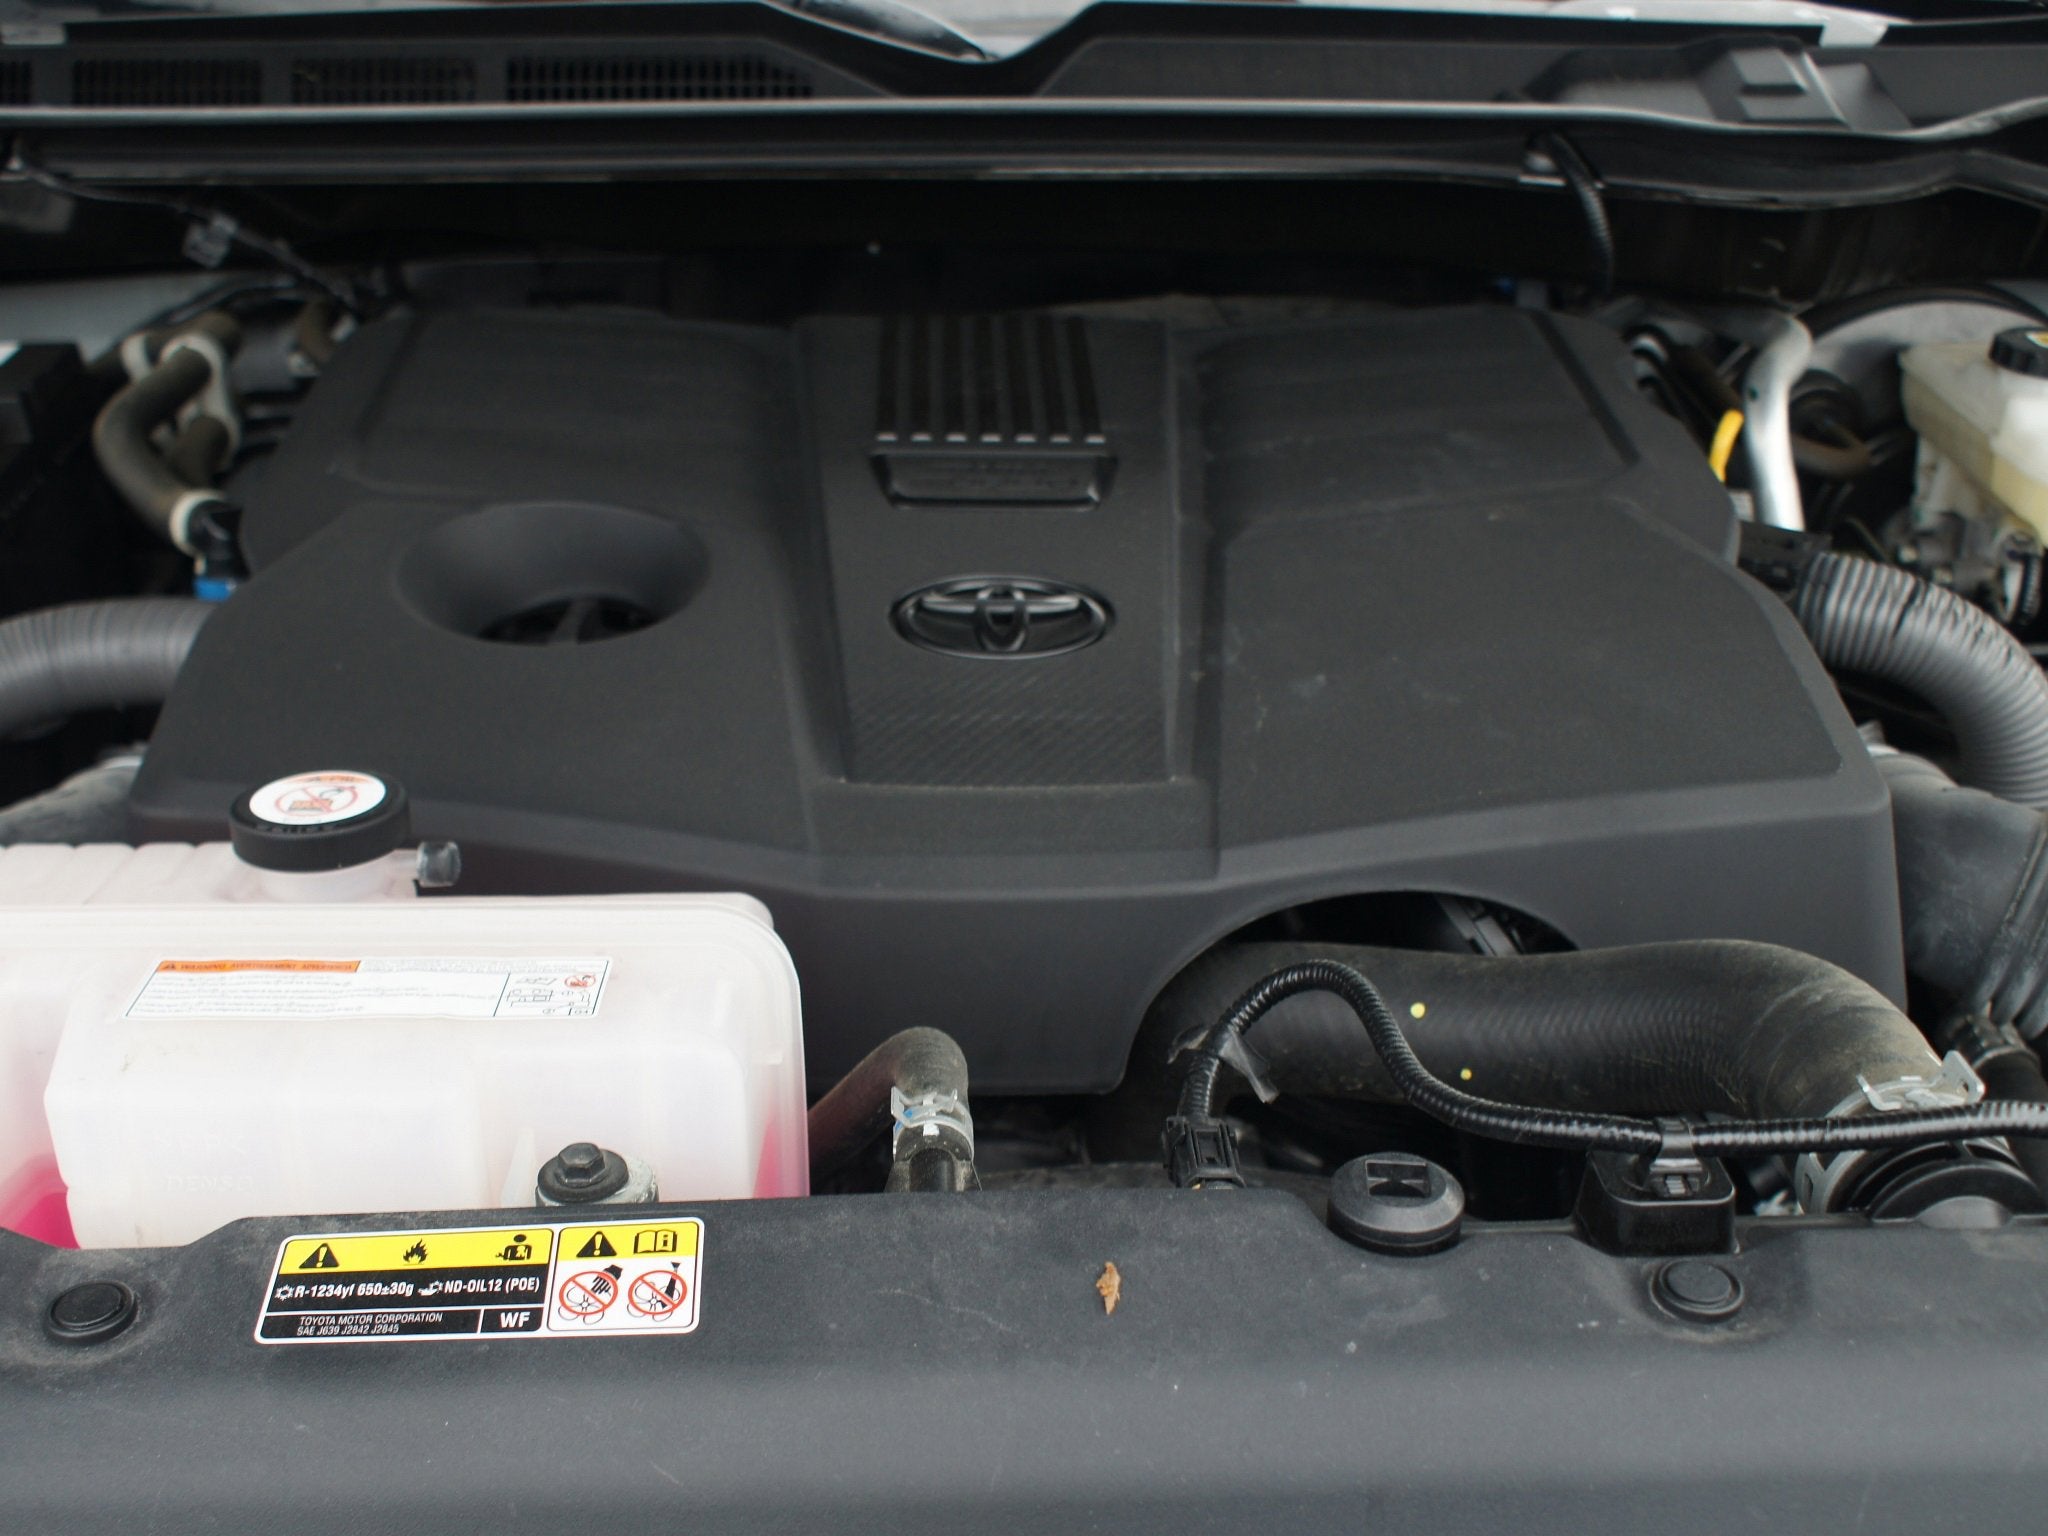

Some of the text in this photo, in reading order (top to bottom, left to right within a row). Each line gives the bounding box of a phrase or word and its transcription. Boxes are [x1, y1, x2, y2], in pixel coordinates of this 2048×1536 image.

[166, 1175, 254, 1193] DENSO
[294, 1284, 353, 1299] R-1234yf
[357, 1282, 414, 1297] 650±30g
[505, 1277, 540, 1294] (POE)
[300, 1312, 443, 1326] TOYOTA MOTOR CORPORATION
[500, 1312, 531, 1328] WF
[296, 1324, 400, 1336] SAE J639 J2842 J2845
